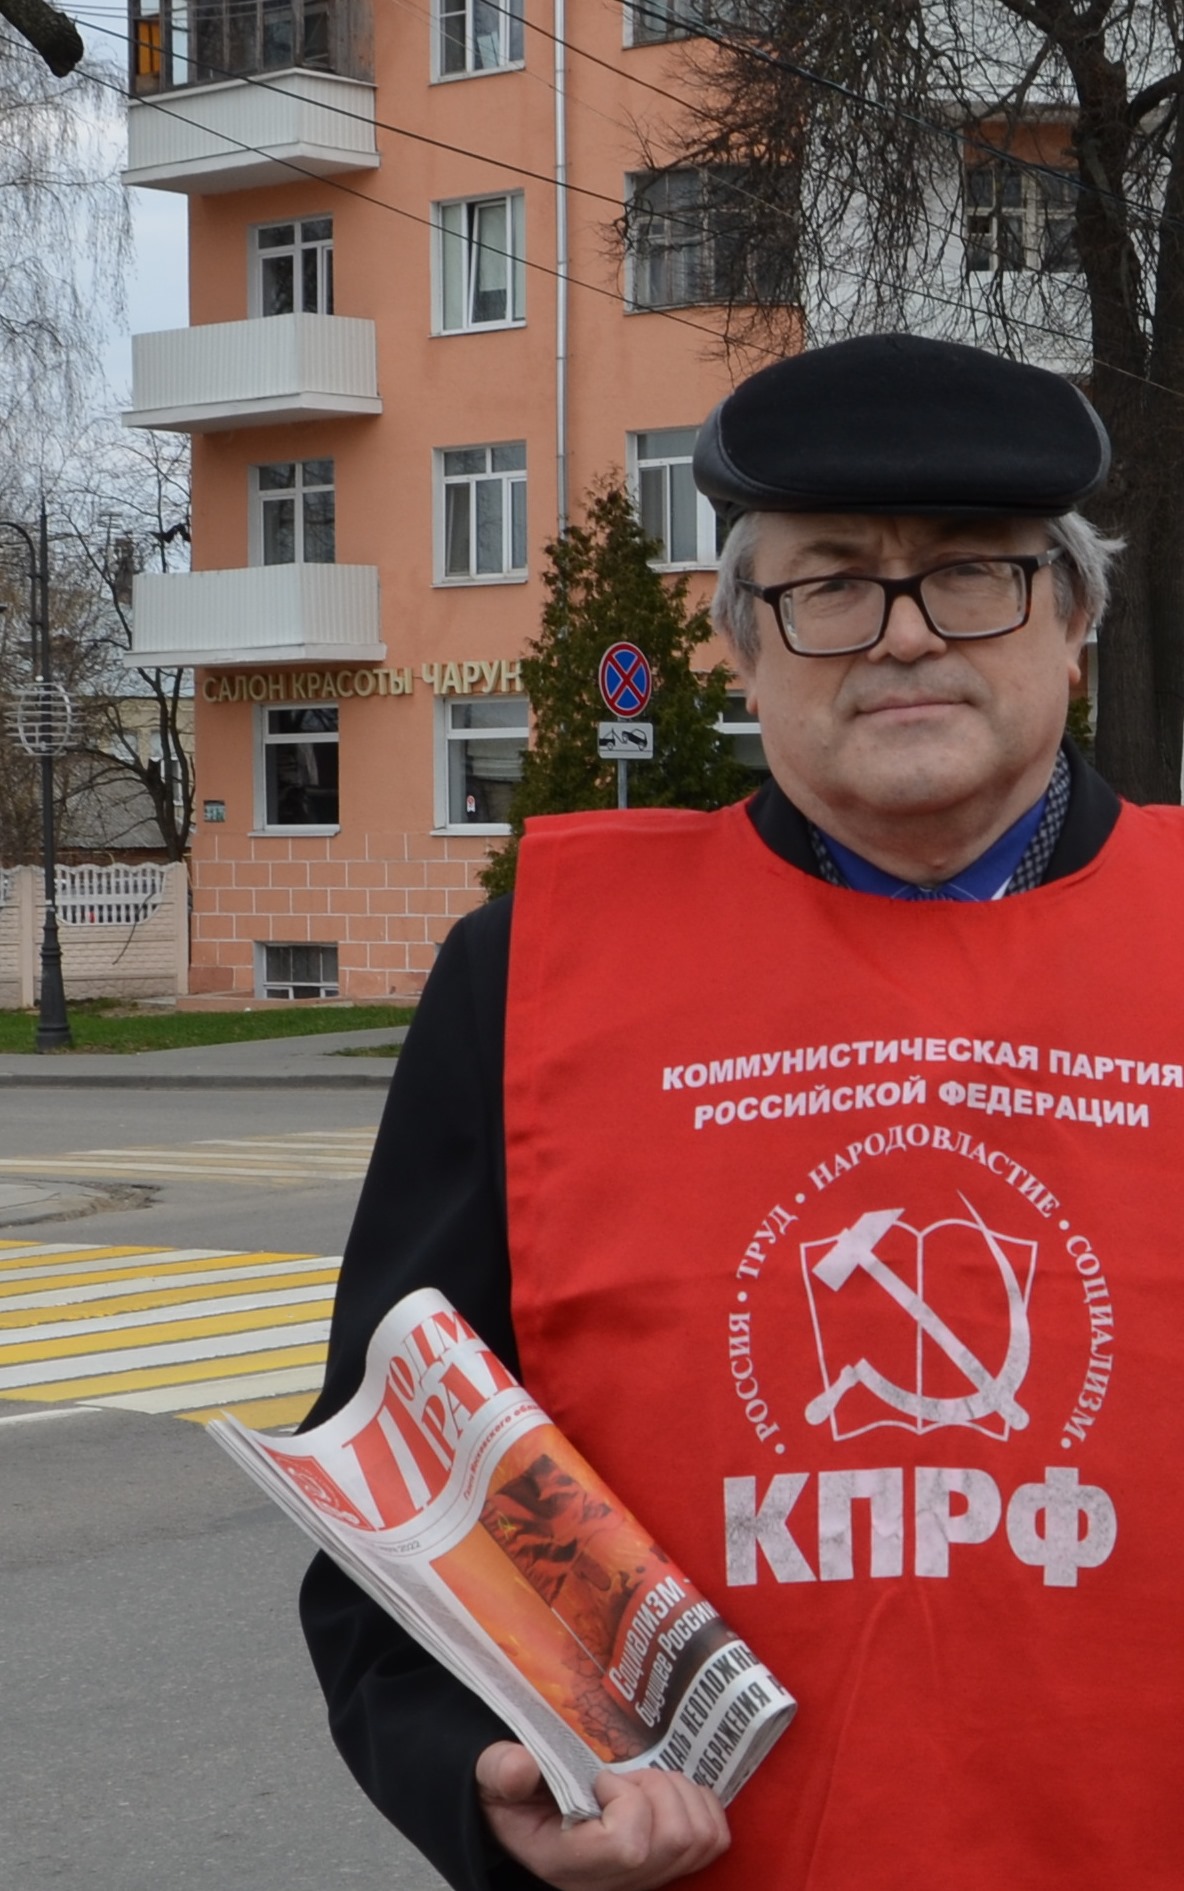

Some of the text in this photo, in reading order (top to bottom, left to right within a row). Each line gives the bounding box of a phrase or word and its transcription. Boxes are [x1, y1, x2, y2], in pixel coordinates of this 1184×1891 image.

[203, 674, 284, 702] САЛОН
[291, 668, 414, 699] КРАСОТЫ
[662, 1037, 1184, 1090] КОММУНИСТИЧЕСКАЯ ПАРТИЯ
[694, 1075, 1150, 1130] РОССИЙСКОЙ ФЕДЕРАЦИИ
[728, 1123, 1115, 1442] РОССИЯ ТРУД НАРОДОВЛАСТИЕ СОЦИАЛИЗМ
[723, 1466, 1118, 1587] КПРФ
[608, 1575, 687, 1701] Социализм
[635, 1652, 674, 1728] будущее
